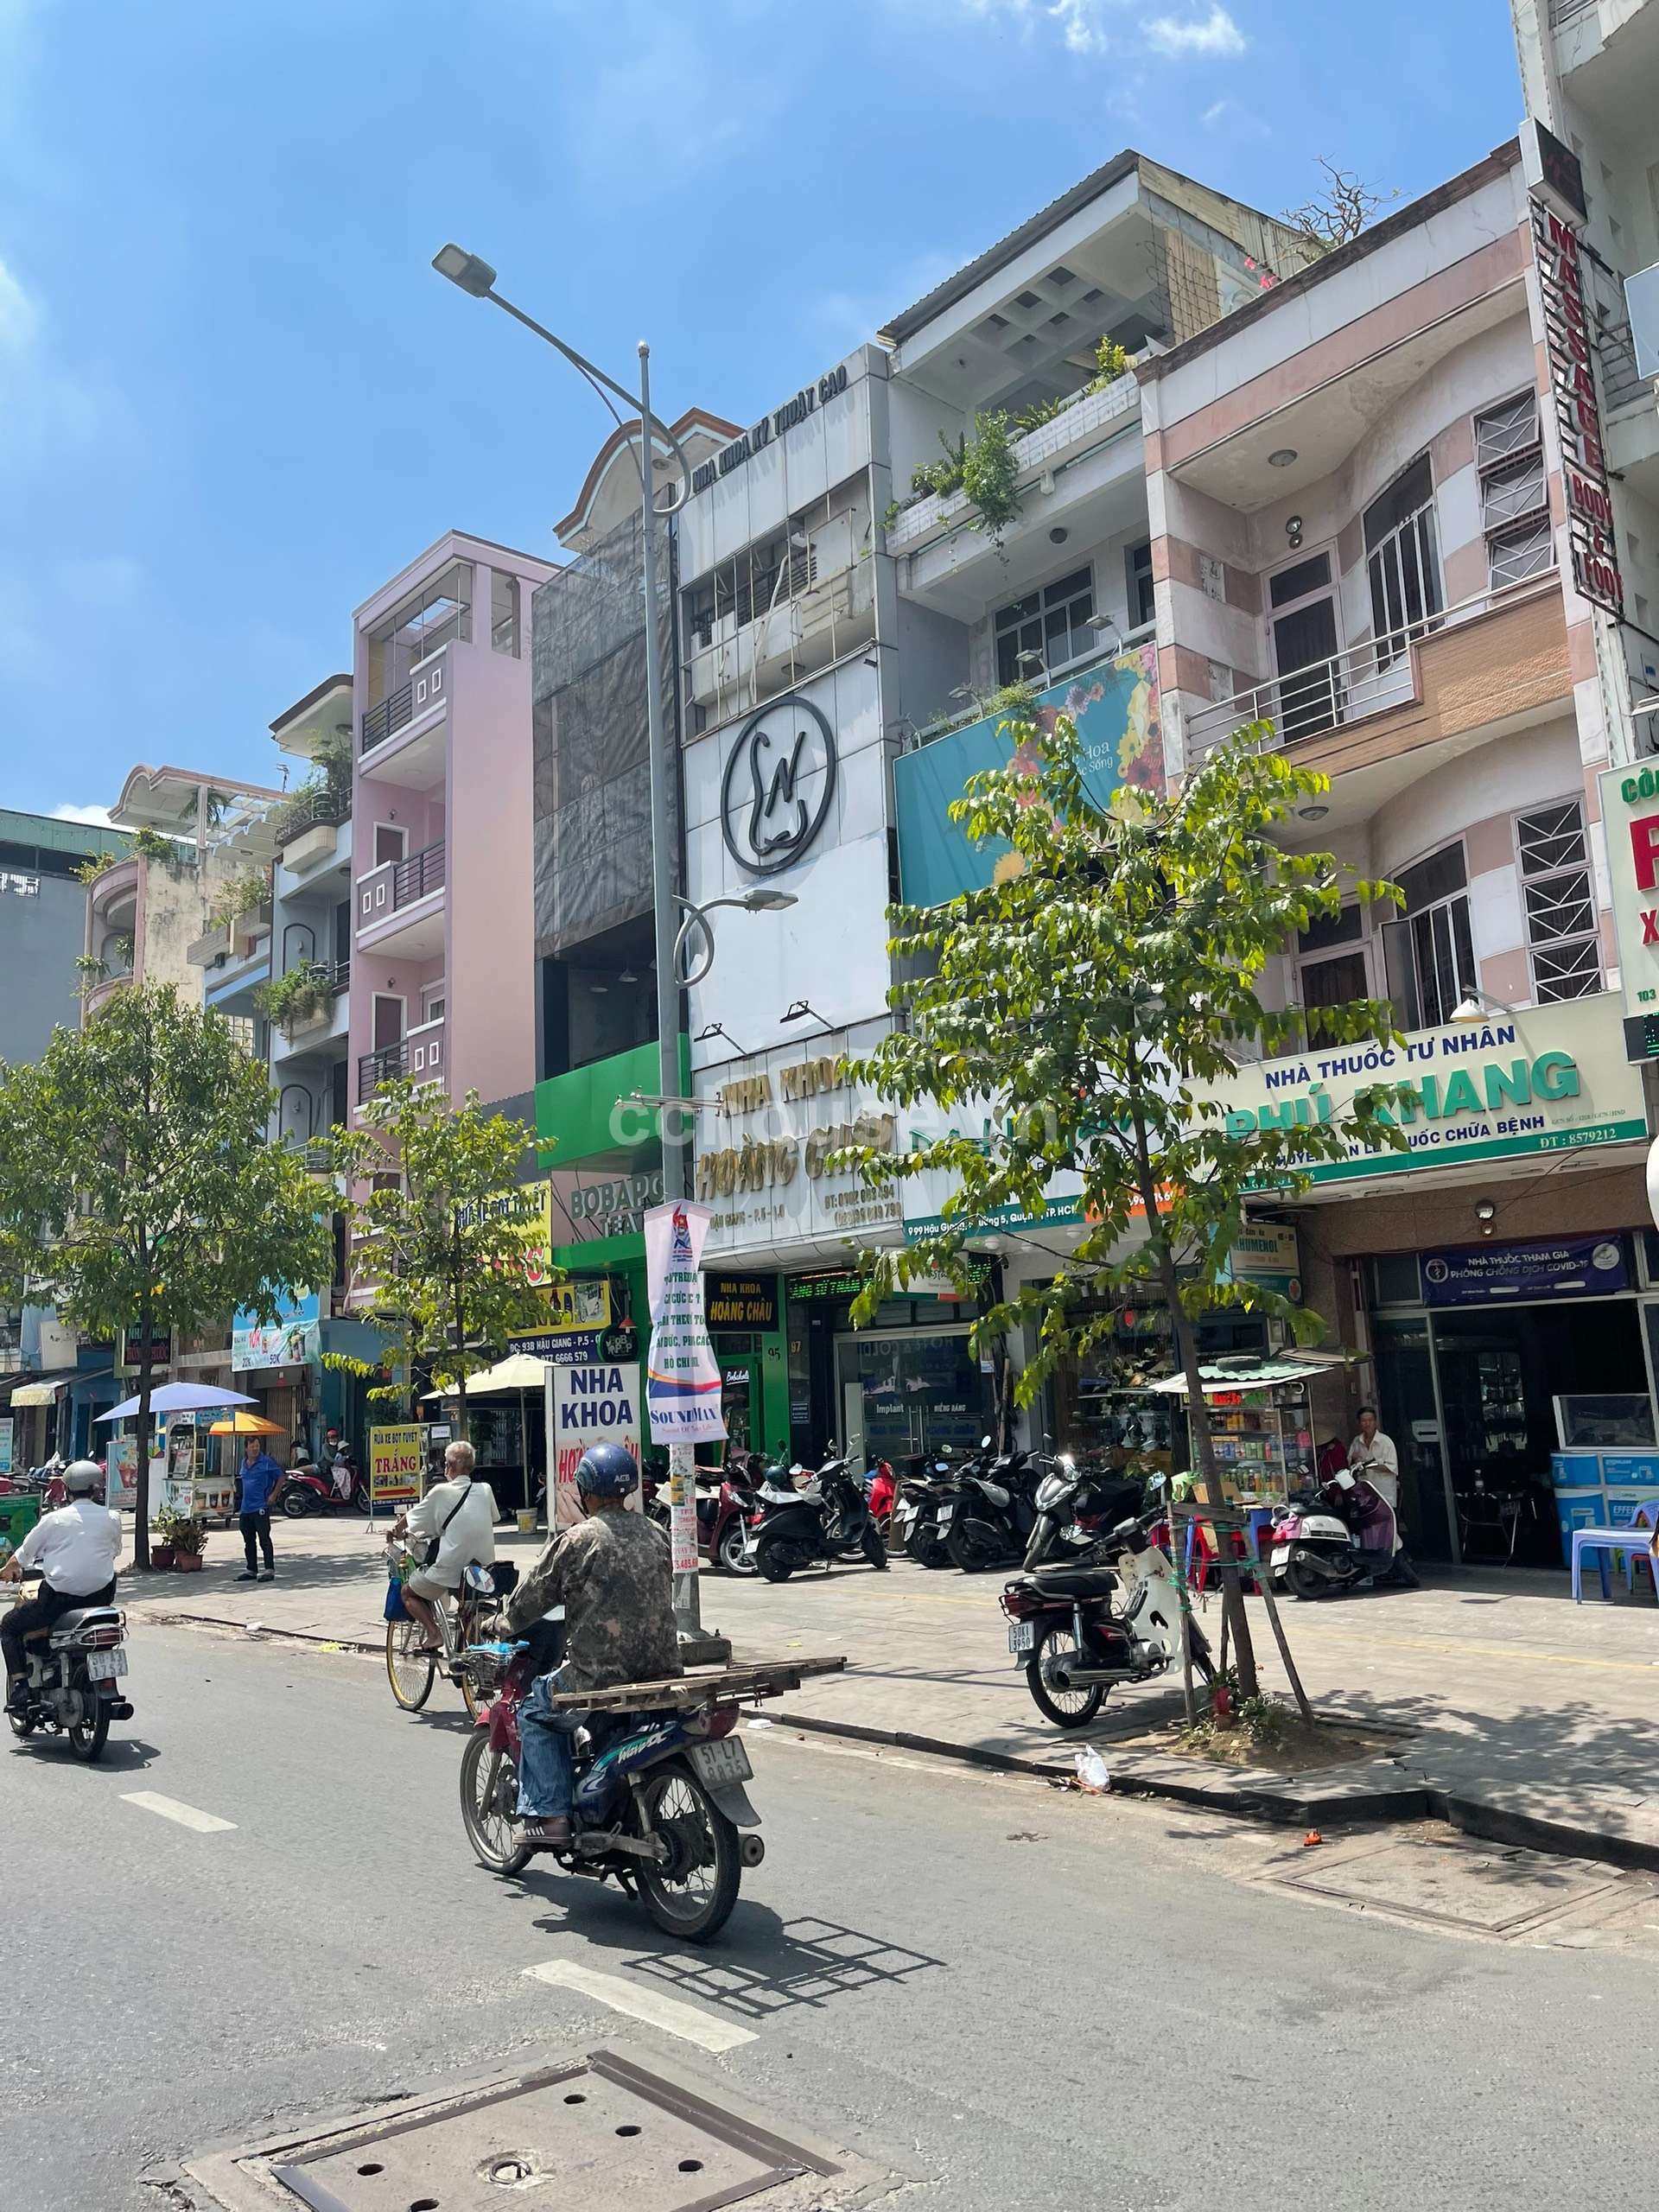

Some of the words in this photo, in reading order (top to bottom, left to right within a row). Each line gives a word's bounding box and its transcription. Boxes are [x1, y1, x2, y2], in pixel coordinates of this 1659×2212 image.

[1546, 211, 1605, 480] MASSAGE
[719, 435, 750, 475] KHOA
[818, 365, 847, 403] CAO
[1572, 474, 1612, 526] BODY
[1582, 552, 1623, 603] FOOT
[1620, 767, 1659, 804] CÔ
[1265, 1062, 1311, 1089] NHÀ
[1317, 1044, 1395, 1079] THUỐC
[1407, 1036, 1436, 1062] TƯ
[1443, 1025, 1515, 1056] NHÂN
[1446, 1121, 1491, 1145] CHỮA
[1497, 1116, 1545, 1135] BỆNH
[1568, 1128, 1617, 1145] 8579212
[601, 1213, 637, 1237] TEA
[924, 1224, 939, 1236] Hậu
[1469, 1256, 1488, 1266] NHÀ
[1522, 1253, 1551, 1262] THAM
[1553, 1250, 1570, 1260] GIA
[720, 1281, 738, 1294] NHA
[740, 1282, 761, 1294] KHOA
[710, 1296, 745, 1322] HOÀNG
[747, 1298, 773, 1322] CHÂU
[522, 1341, 535, 1352] 93B
[536, 1338, 550, 1354] HẬU
[552, 1338, 573, 1349] GIANG
[578, 1336, 589, 1346] P.5
[556, 1352, 574, 1363] 6666
[575, 1351, 588, 1362] 579
[768, 1347, 780, 1361] 95
[791, 1341, 801, 1353] 97
[570, 1368, 624, 1395] NHA
[562, 1400, 633, 1429] KHOA
[876, 1403, 904, 1414] Implant
[375, 1448, 416, 1473] TRẮNG
